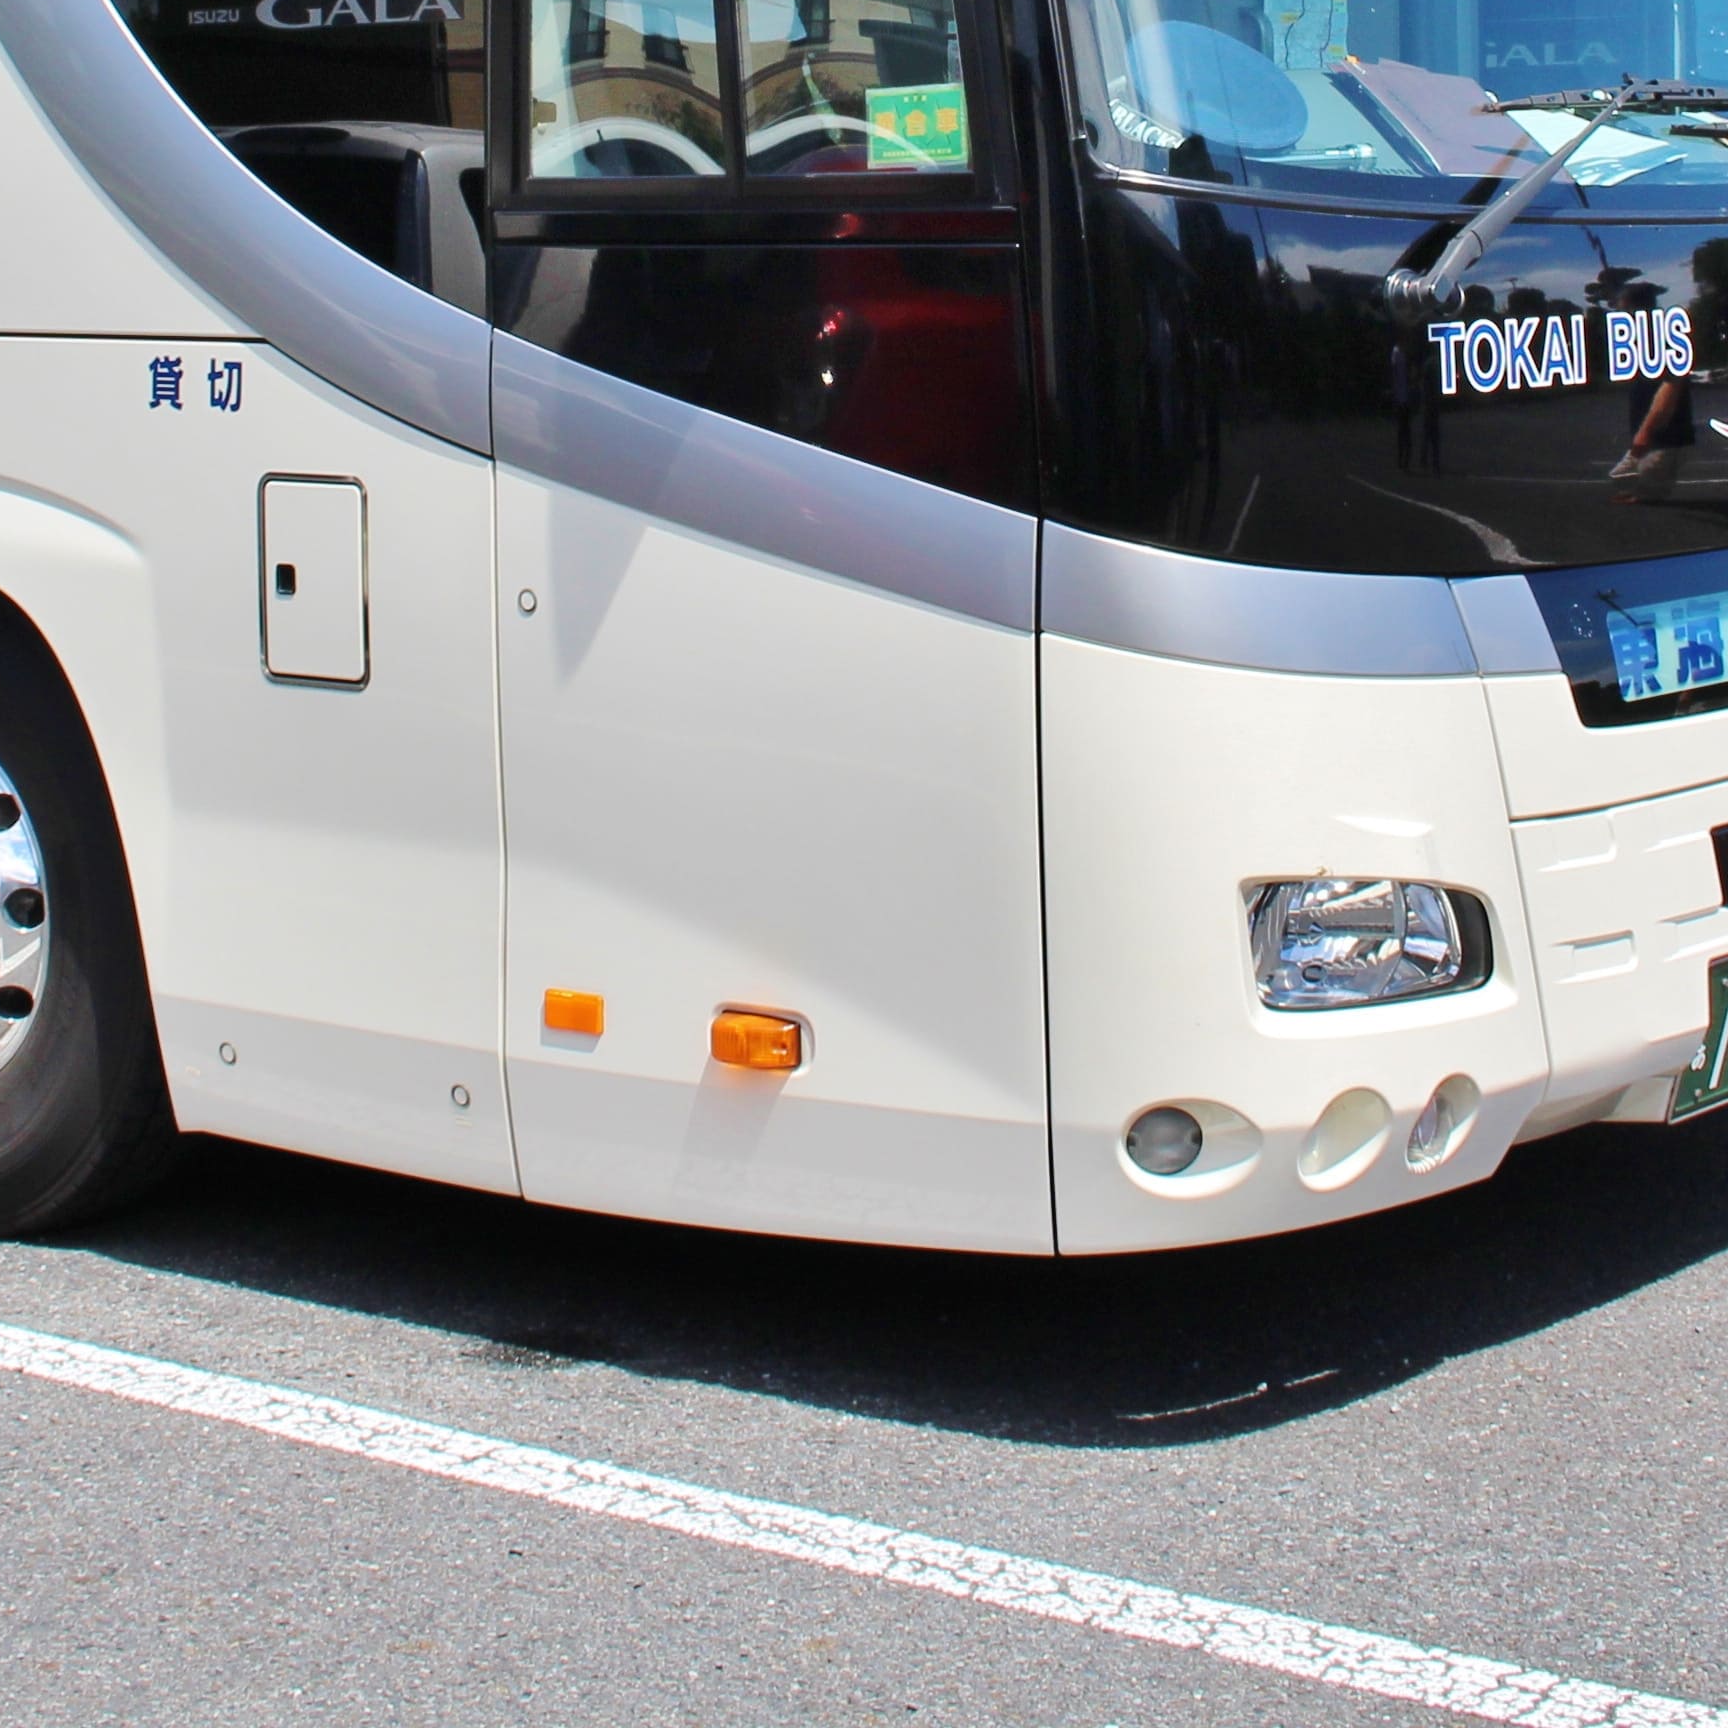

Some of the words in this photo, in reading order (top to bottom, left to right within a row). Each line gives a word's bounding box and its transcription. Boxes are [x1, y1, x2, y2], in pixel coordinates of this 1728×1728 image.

[188, 9, 240, 24] ISUZU
[1428, 315, 1586, 394] TOKAI
[1607, 307, 1693, 381] BUS
[149, 356, 242, 412] 貸切
